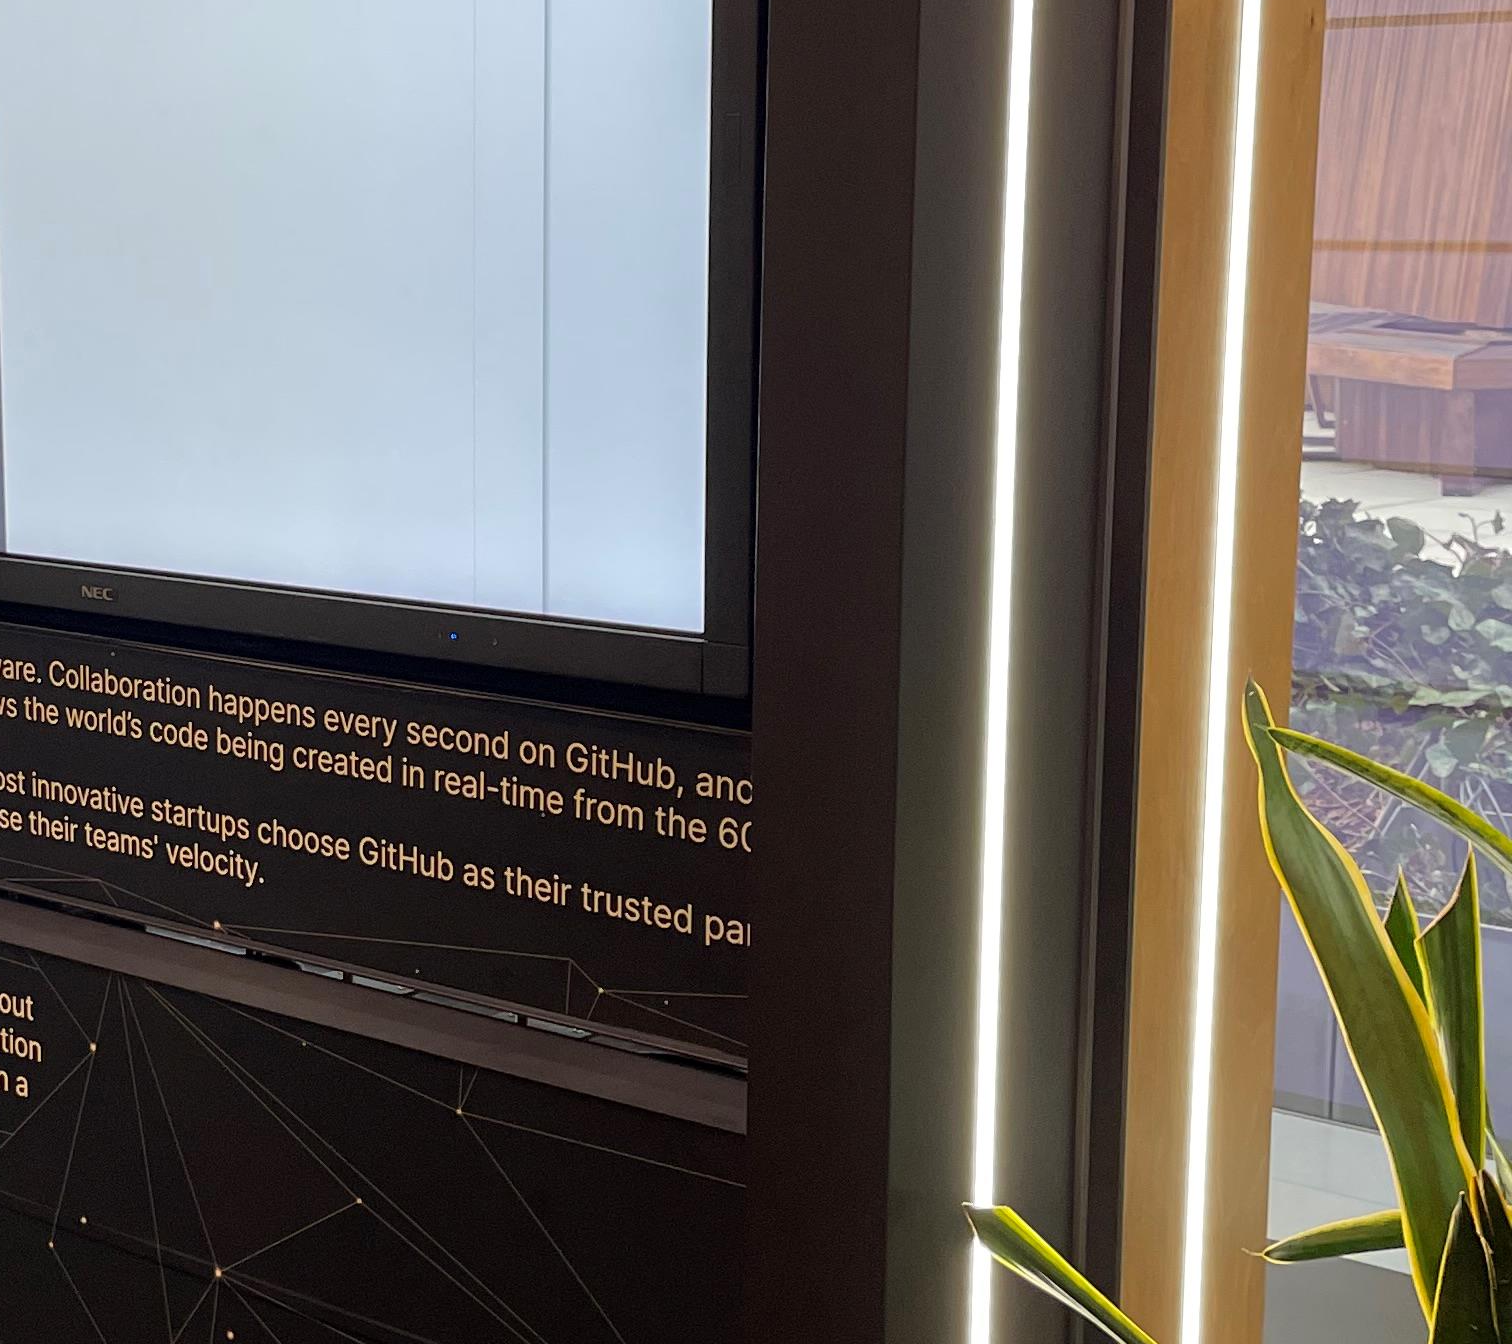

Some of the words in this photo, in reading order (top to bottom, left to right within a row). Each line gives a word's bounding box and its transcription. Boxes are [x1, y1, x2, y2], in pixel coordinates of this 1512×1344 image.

[81, 585, 113, 601] NEC
[23, 696, 59, 725] the
[65, 706, 143, 739] world's
[150, 720, 208, 751] code
[216, 726, 284, 771] being
[293, 744, 392, 784] created
[401, 757, 424, 789] in
[434, 767, 564, 815] real-time
[573, 787, 644, 831] from
[655, 806, 707, 844] the
[48, 660, 200, 708] Collaboration
[208, 685, 316, 728] happens
[323, 708, 397, 747] every
[406, 719, 510, 760] second
[519, 740, 556, 769] on
[566, 741, 684, 798] GitHub,
[29, 811, 79, 843] their
[84, 822, 159, 860] teams'
[166, 842, 266, 888] velocity.
[31, 771, 144, 818] innovative
[151, 798, 250, 842] startups
[257, 820, 350, 861] choose
[359, 836, 454, 882] GitHub
[463, 862, 496, 890] as
[504, 866, 571, 906] their
[580, 882, 693, 934] trusted
[15, 1077, 29, 1098] a
